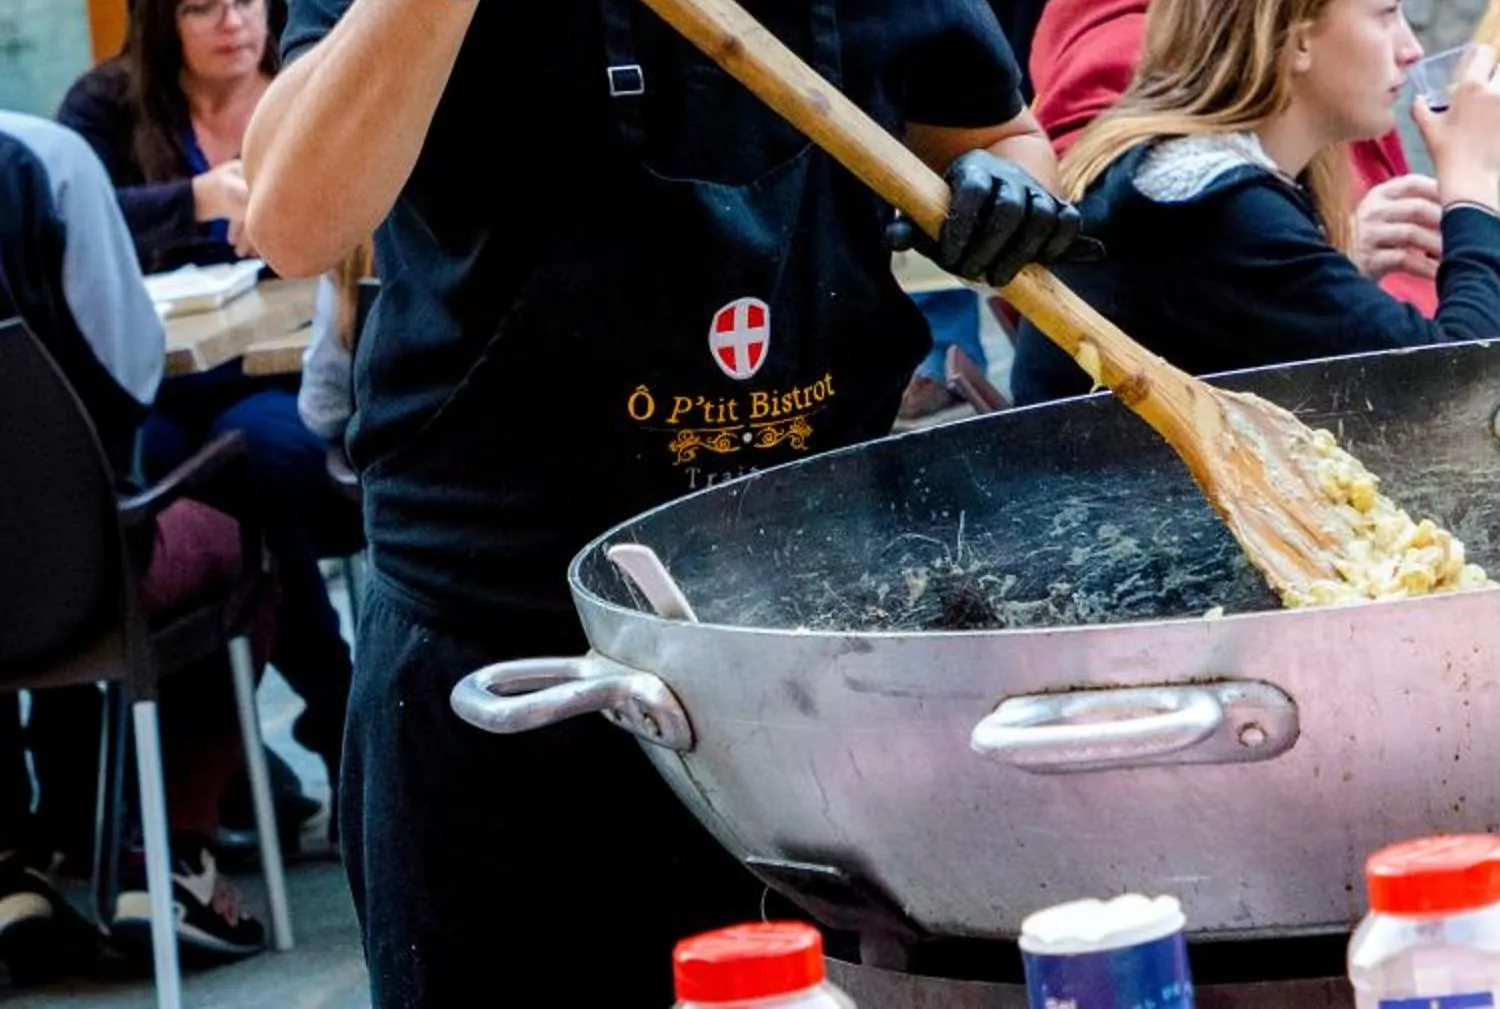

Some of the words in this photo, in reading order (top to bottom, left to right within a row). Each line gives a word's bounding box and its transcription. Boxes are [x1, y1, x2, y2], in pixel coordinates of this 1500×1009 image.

[627, 384, 656, 421] Ô
[665, 394, 739, 424] P'tit
[750, 371, 836, 419] Bistrot
[685, 465, 761, 489] Trai
